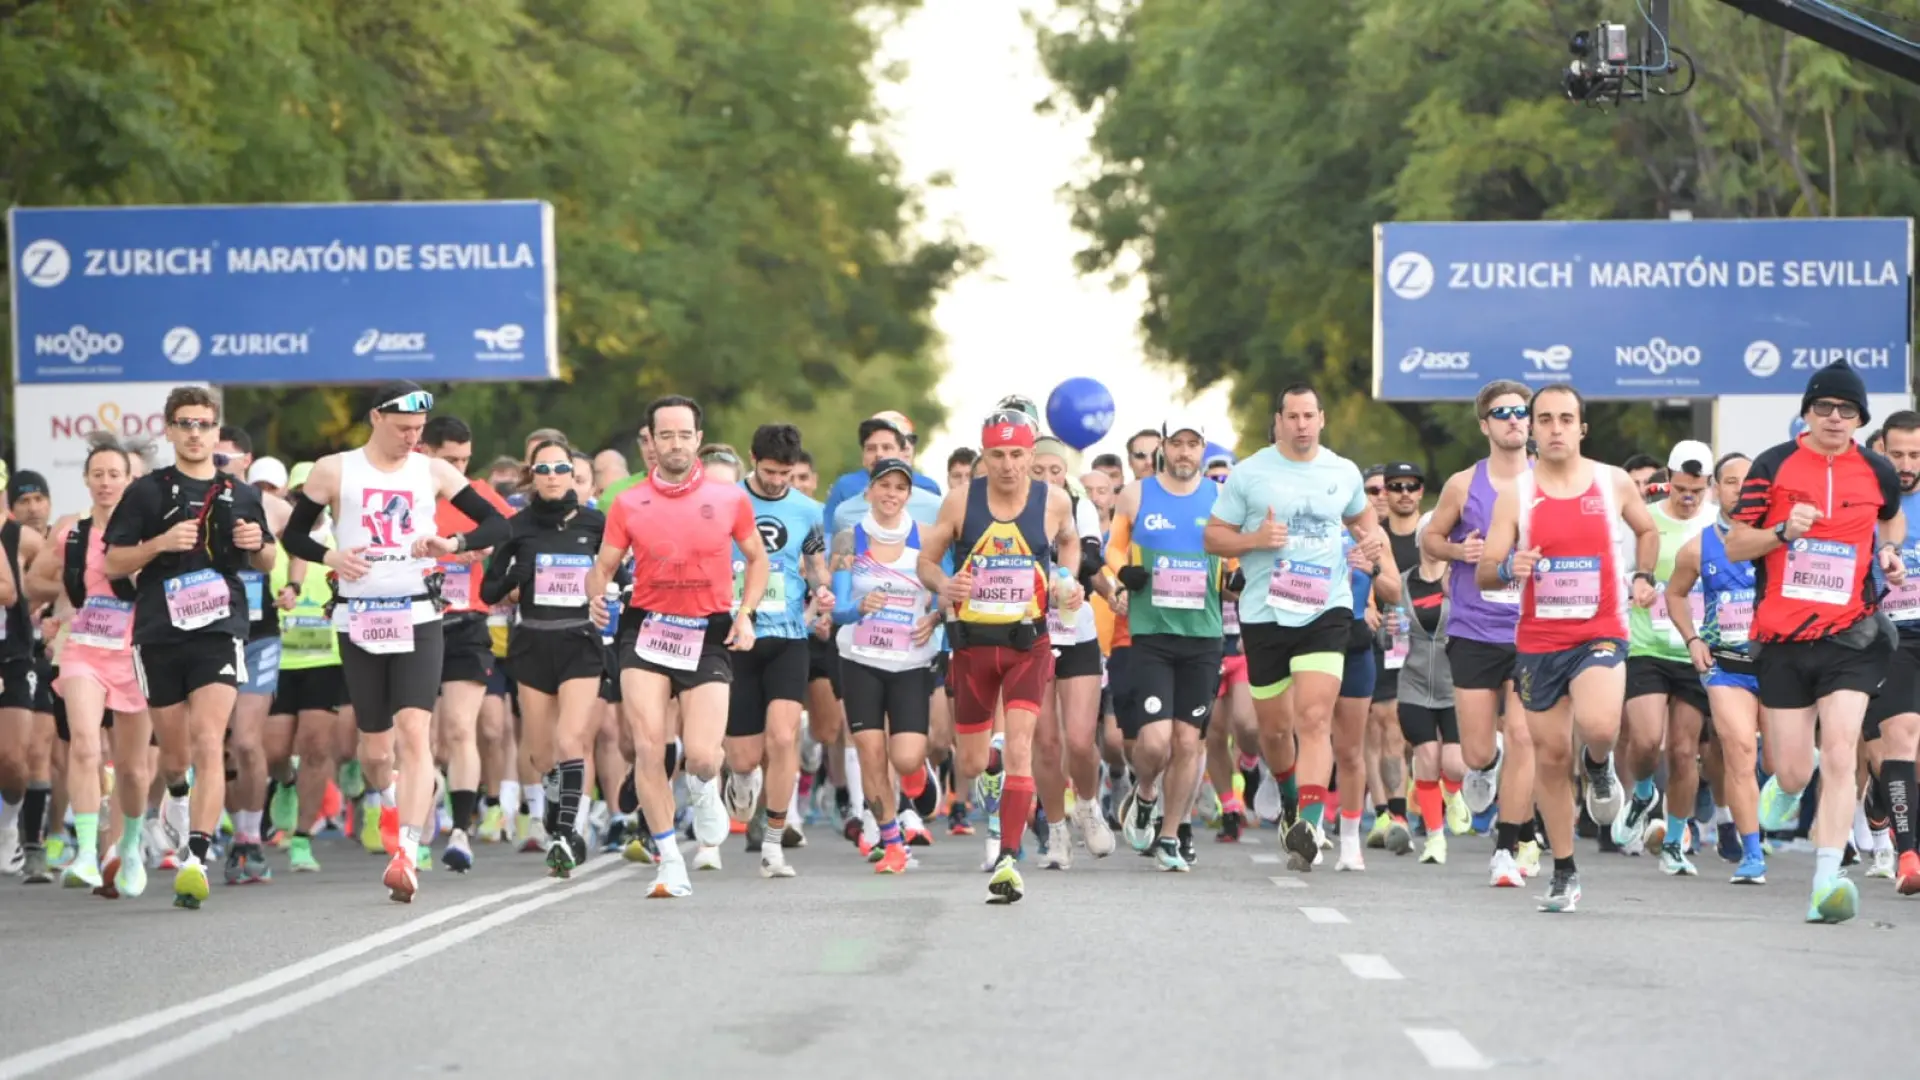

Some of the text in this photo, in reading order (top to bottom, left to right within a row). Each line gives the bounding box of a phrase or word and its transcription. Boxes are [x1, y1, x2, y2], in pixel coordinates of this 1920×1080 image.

[84, 248, 210, 275] ZURICH
[228, 240, 367, 273] MARATÓN
[374, 245, 412, 270] DE
[419, 243, 534, 270] SEVILLA
[1449, 261, 1573, 288] ZURICH
[1590, 255, 1729, 287] MARATÓN
[1737, 262, 1774, 287] DE
[1783, 260, 1898, 286] SEVILLA
[211, 333, 308, 355] ZURICH
[376, 332, 427, 352] asics
[1423, 351, 1471, 370] asics
[1791, 347, 1888, 369] ZURICH
[1811, 542, 1850, 556] ZURICH
[555, 556, 588, 565] ZURICH
[990, 559, 1029, 568] ZURICH
[1172, 559, 1204, 568] ZURICH
[1555, 560, 1592, 569] ZURICH
[1294, 565, 1326, 577] ZURICH
[1793, 571, 1844, 589] RENAUD
[548, 582, 580, 595] ANITA
[976, 587, 1025, 600] JOSE FT
[174, 595, 227, 617] THIBAULT
[1883, 598, 1917, 610] ANTONIO
[362, 627, 401, 641] GODAL
[869, 634, 894, 649] IZAN
[646, 637, 692, 657] JUANLU
[1888, 780, 1910, 834] ENFORMA
